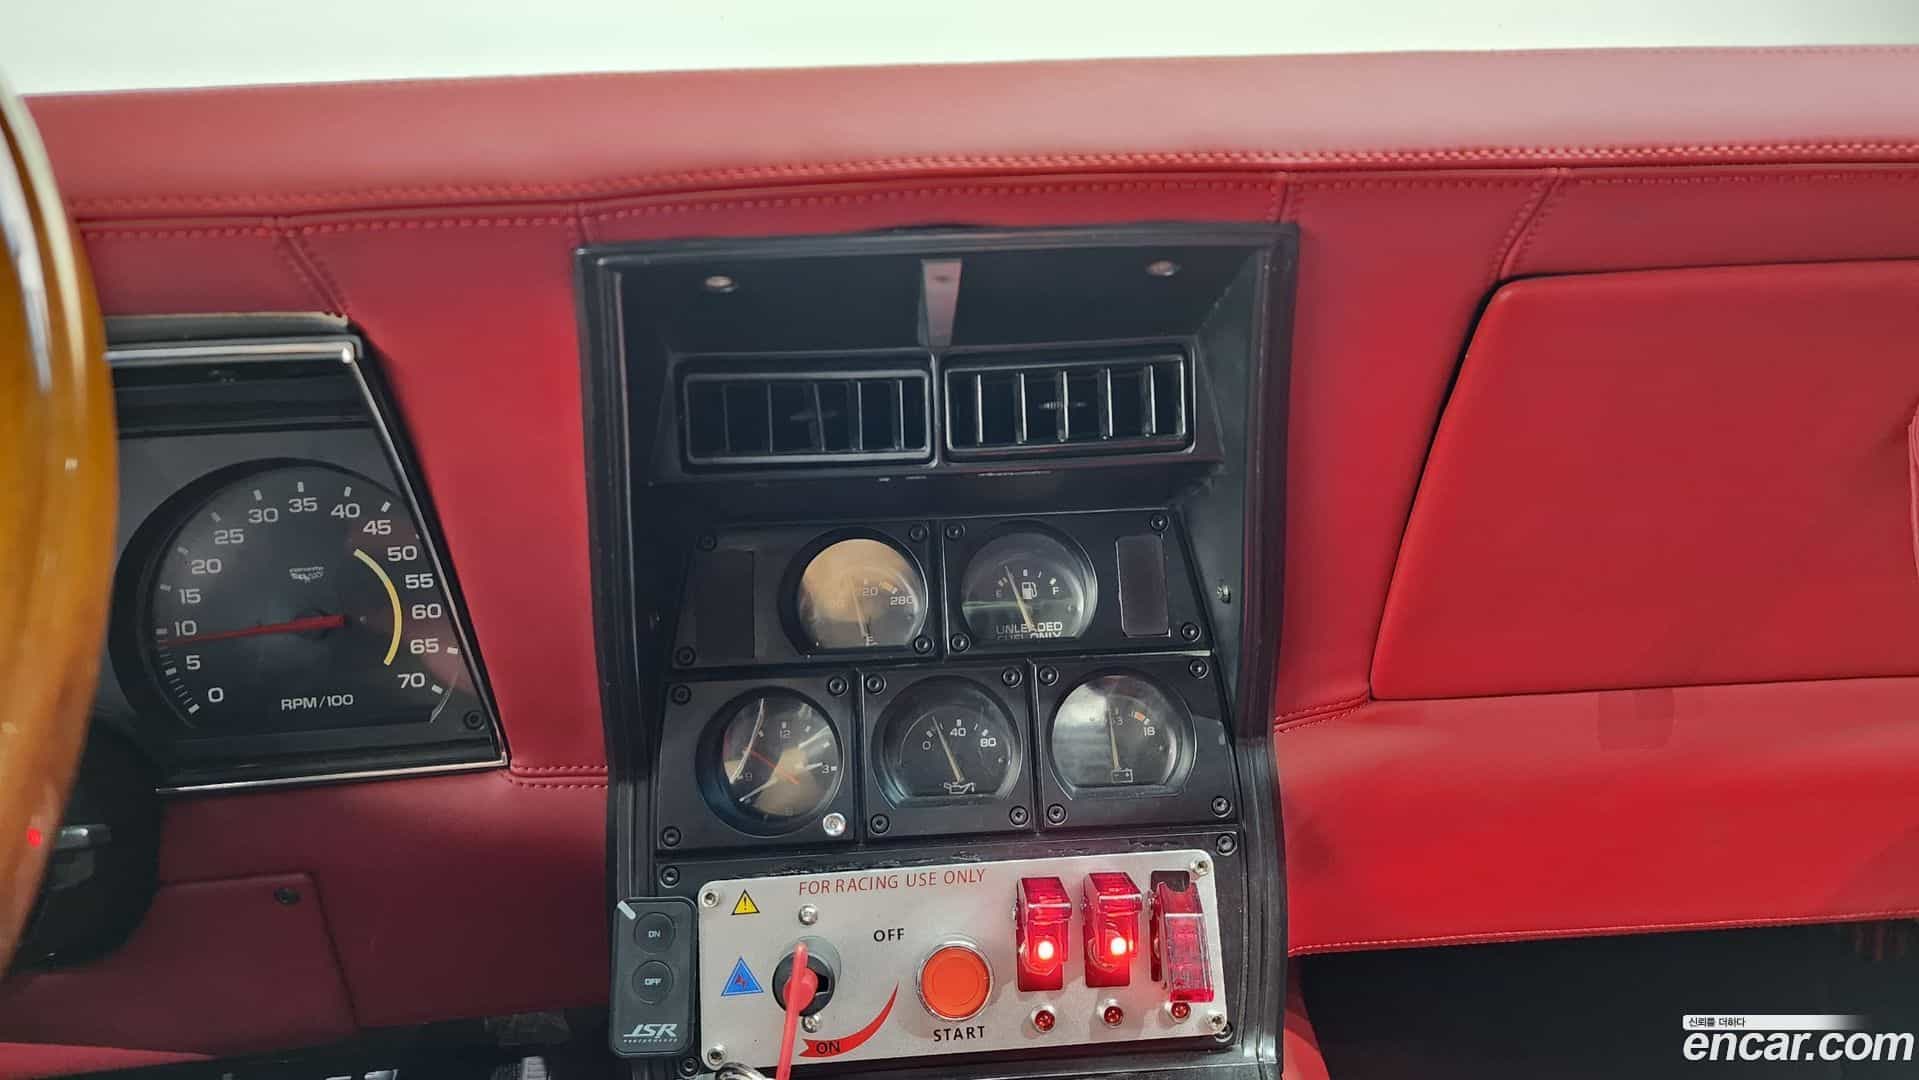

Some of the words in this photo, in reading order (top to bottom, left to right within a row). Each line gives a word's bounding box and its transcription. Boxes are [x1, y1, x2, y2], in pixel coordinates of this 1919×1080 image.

[288, 498, 318, 513] 35
[330, 503, 360, 519] 40
[248, 508, 279, 523] 30
[363, 520, 392, 535] 45
[214, 529, 244, 545] 25
[387, 546, 417, 561] 50
[191, 559, 222, 574] 20
[405, 573, 434, 589] 55
[179, 588, 202, 604] 15
[1052, 586, 1060, 595] F
[890, 595, 914, 606] 280
[411, 604, 442, 619] 60
[175, 621, 197, 636] 10
[996, 621, 1063, 634] UNLEADED
[410, 639, 440, 654] 65
[186, 655, 200, 670] 5
[398, 673, 425, 688] 70
[207, 688, 224, 702] 0
[281, 694, 354, 711] RPM/100
[950, 727, 967, 737] 40
[922, 741, 931, 750] 0
[980, 737, 997, 748] 80
[822, 764, 830, 774] 3
[799, 879, 830, 896] FOR
[835, 875, 899, 893] RACING
[906, 872, 937, 888] USE
[944, 868, 986, 885] ONLY
[648, 930, 661, 938] ON
[873, 928, 905, 942] OFF
[644, 977, 662, 986] OFF
[933, 1025, 985, 1042] START
[816, 1040, 841, 1054] ON
